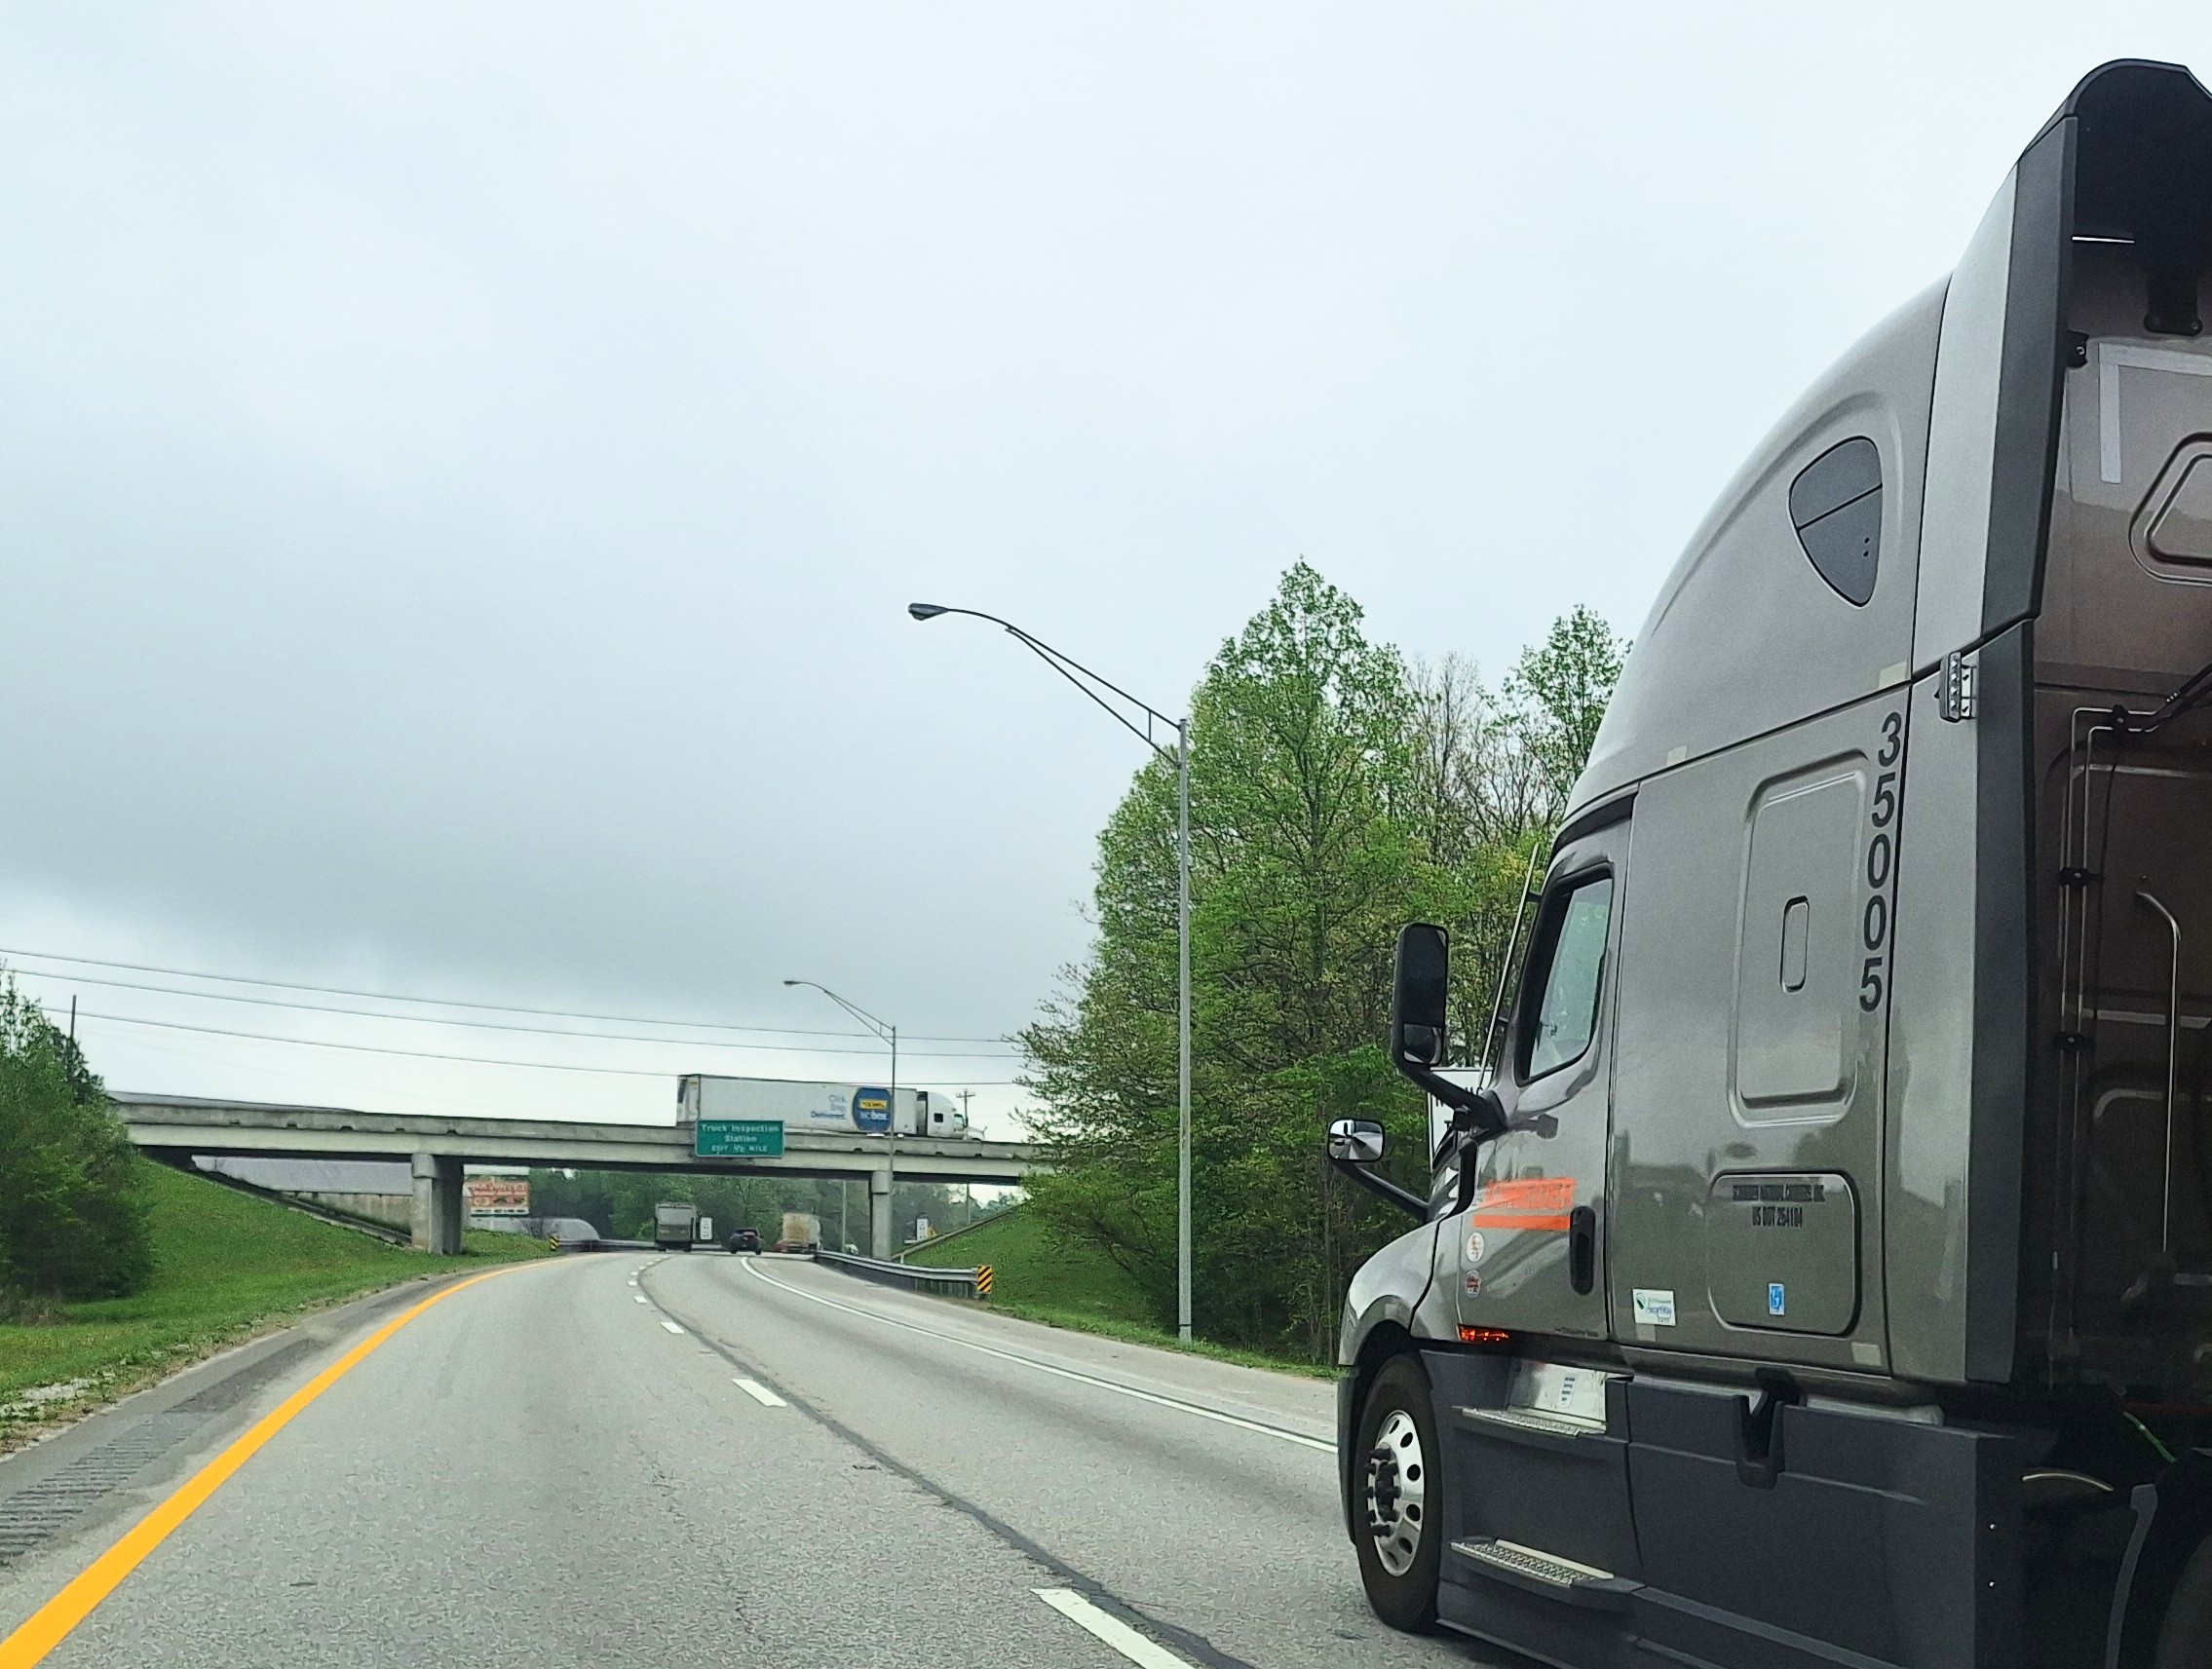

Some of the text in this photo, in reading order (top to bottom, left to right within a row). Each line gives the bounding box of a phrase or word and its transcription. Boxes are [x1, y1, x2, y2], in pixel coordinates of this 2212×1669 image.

[1859, 711, 1902, 1013] 35005
[702, 1123, 780, 1133] Truck Inspection
[724, 1134, 757, 1143] Station
